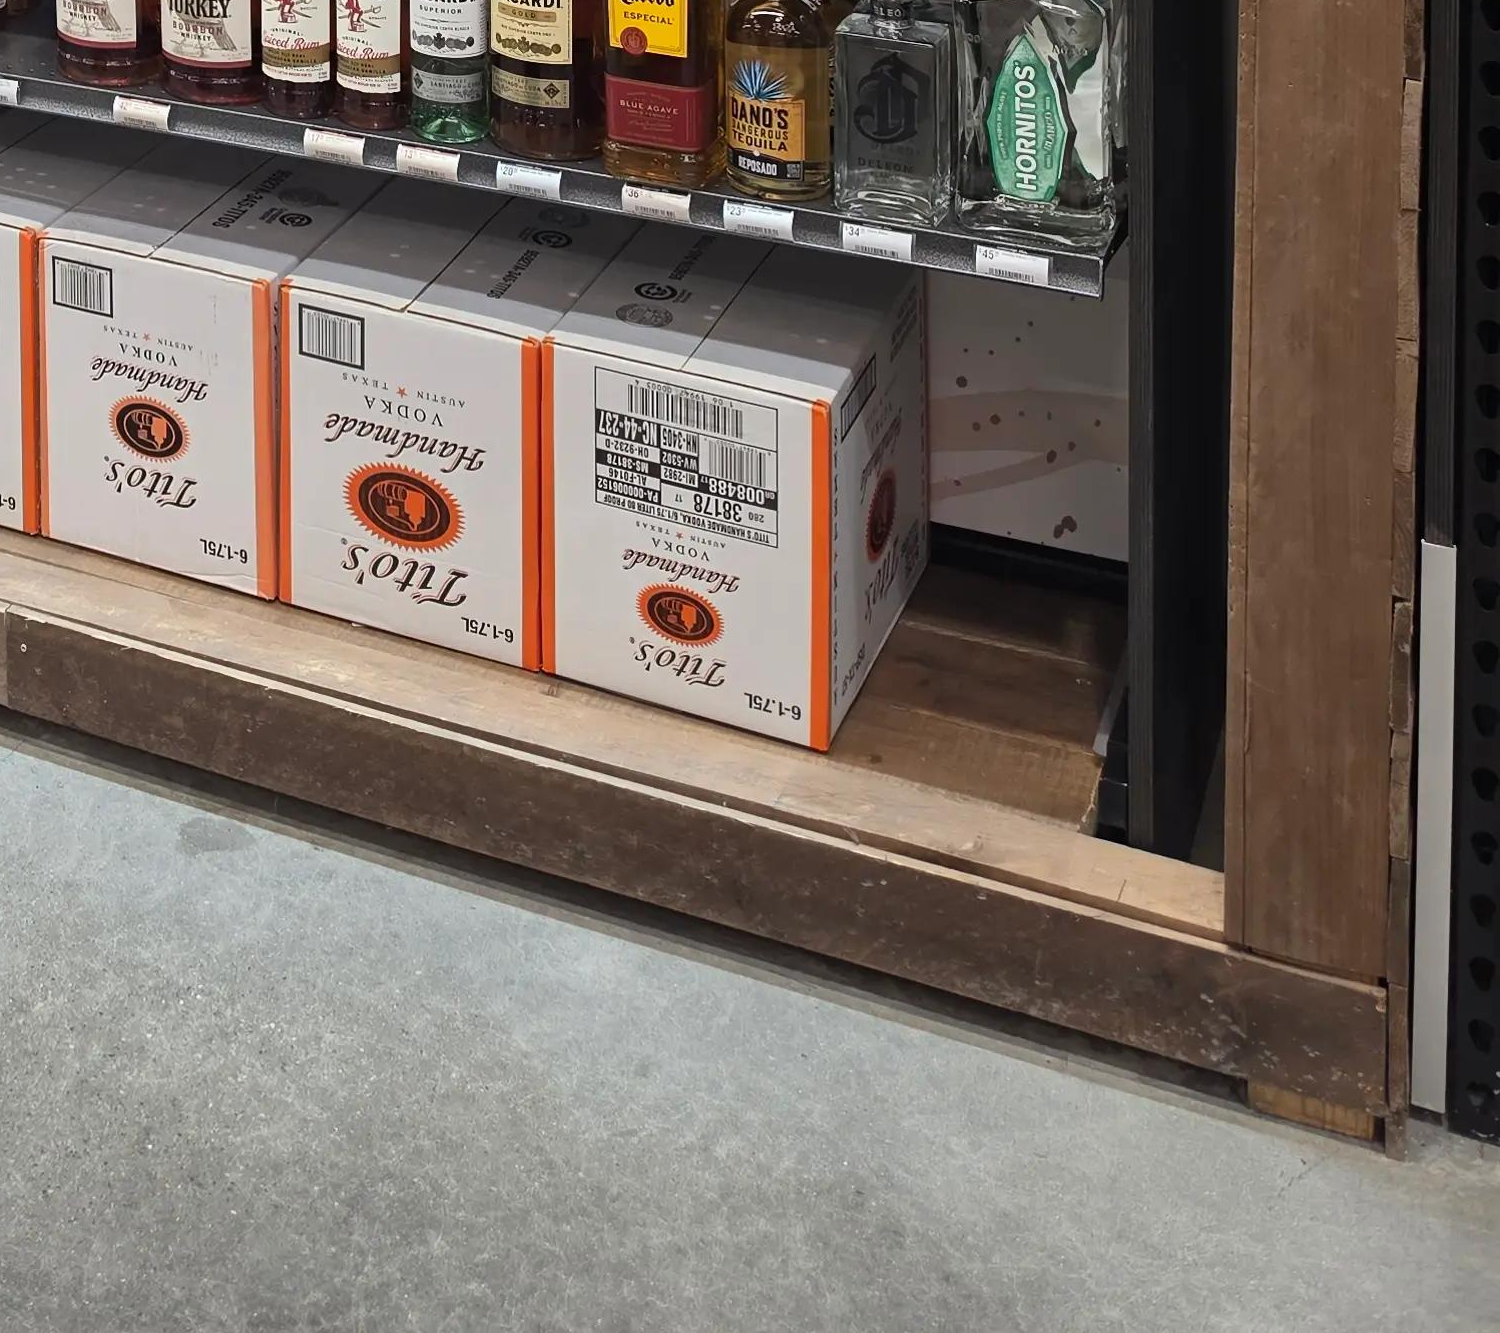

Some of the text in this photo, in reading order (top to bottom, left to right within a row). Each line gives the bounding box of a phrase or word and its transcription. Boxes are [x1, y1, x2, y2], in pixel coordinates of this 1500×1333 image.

[419, 4, 463, 15] SUPERIOR
[511, 9, 537, 19] GOLD
[623, 11, 674, 26] ESPECIAL
[172, 19, 224, 35] BOURBON
[619, 99, 679, 115] BLUE AGAVE
[730, 96, 789, 130] DANO'S
[732, 118, 789, 141] DANGEROUS
[1014, 64, 1037, 191] HORNITOS
[731, 132, 789, 152] TEQUILA
[737, 154, 779, 177] REPOSADO
[118, 342, 178, 367] VODKA
[91, 356, 209, 403] Handmade
[342, 372, 466, 408] AUSTIN TEXAS
[363, 395, 444, 427] VODKA
[598, 410, 658, 447] NC-44-237
[662, 428, 698, 454] NH-3405
[324, 412, 486, 474] Handmade
[604, 438, 649, 458] OH-9232-D
[607, 452, 649, 474] MS-38178
[662, 451, 698, 470] WV-5302
[106, 462, 198, 509] Tito's
[608, 467, 647, 487] AL-F0146
[662, 467, 696, 487] MI-2982
[597, 477, 659, 504] PA-000006152
[708, 479, 765, 505] 008488
[693, 493, 743, 523] 38178
[747, 511, 764, 523] 280
[199, 538, 248, 564] 6-1.75L
[650, 536, 711, 562] VODKA
[341, 544, 468, 607] Tito's
[621, 547, 741, 594] Handmade
[461, 616, 514, 643] 6-1.75L
[634, 642, 728, 687] Tito's
[744, 692, 802, 721] 6-1.75L
